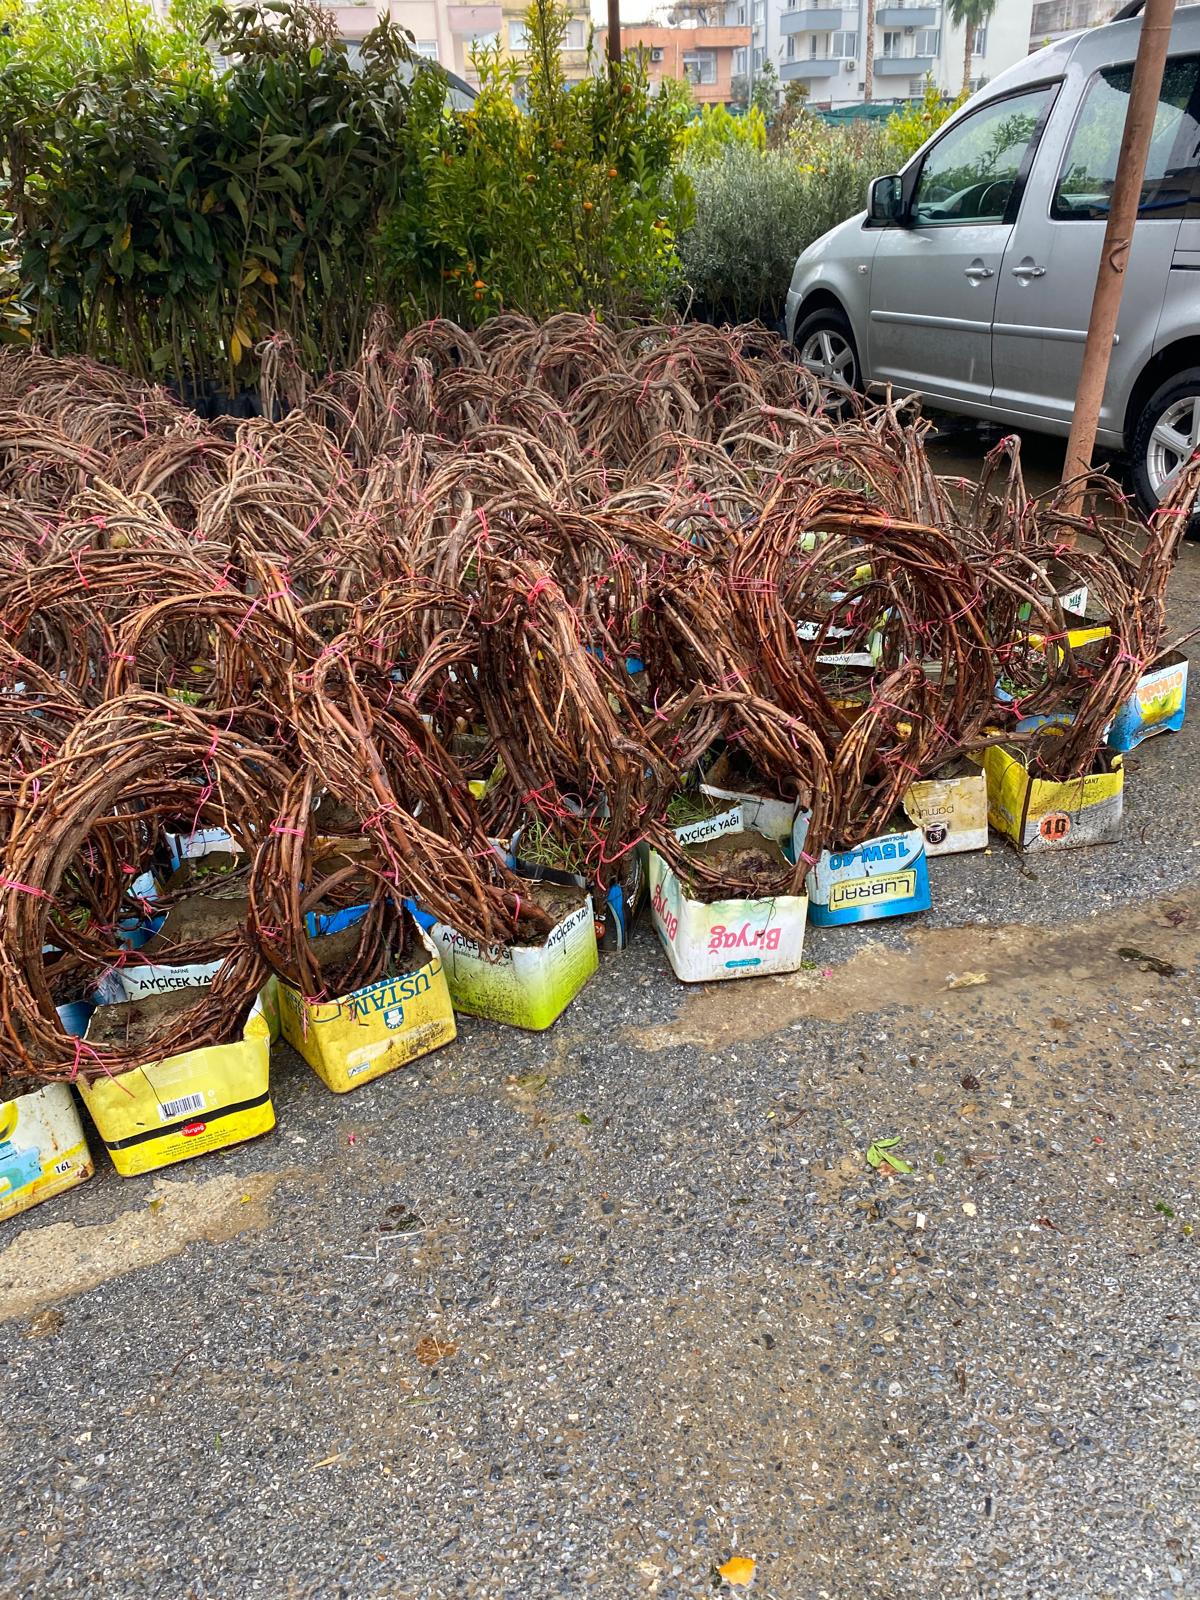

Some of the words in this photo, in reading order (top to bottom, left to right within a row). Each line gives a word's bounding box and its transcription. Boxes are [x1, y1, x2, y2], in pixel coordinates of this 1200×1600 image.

[678, 823, 717, 843] AYÇİÇEK
[718, 814, 739, 830] YAĞI
[1043, 818, 1068, 836] 10
[829, 841, 910, 871] 15W-40
[833, 879, 910, 902] LUBRAN
[707, 922, 782, 956] Biryağ
[139, 976, 191, 991] AYÇİÇEK
[347, 973, 431, 1020] USTAM
[55, 1163, 72, 1174] 16L
